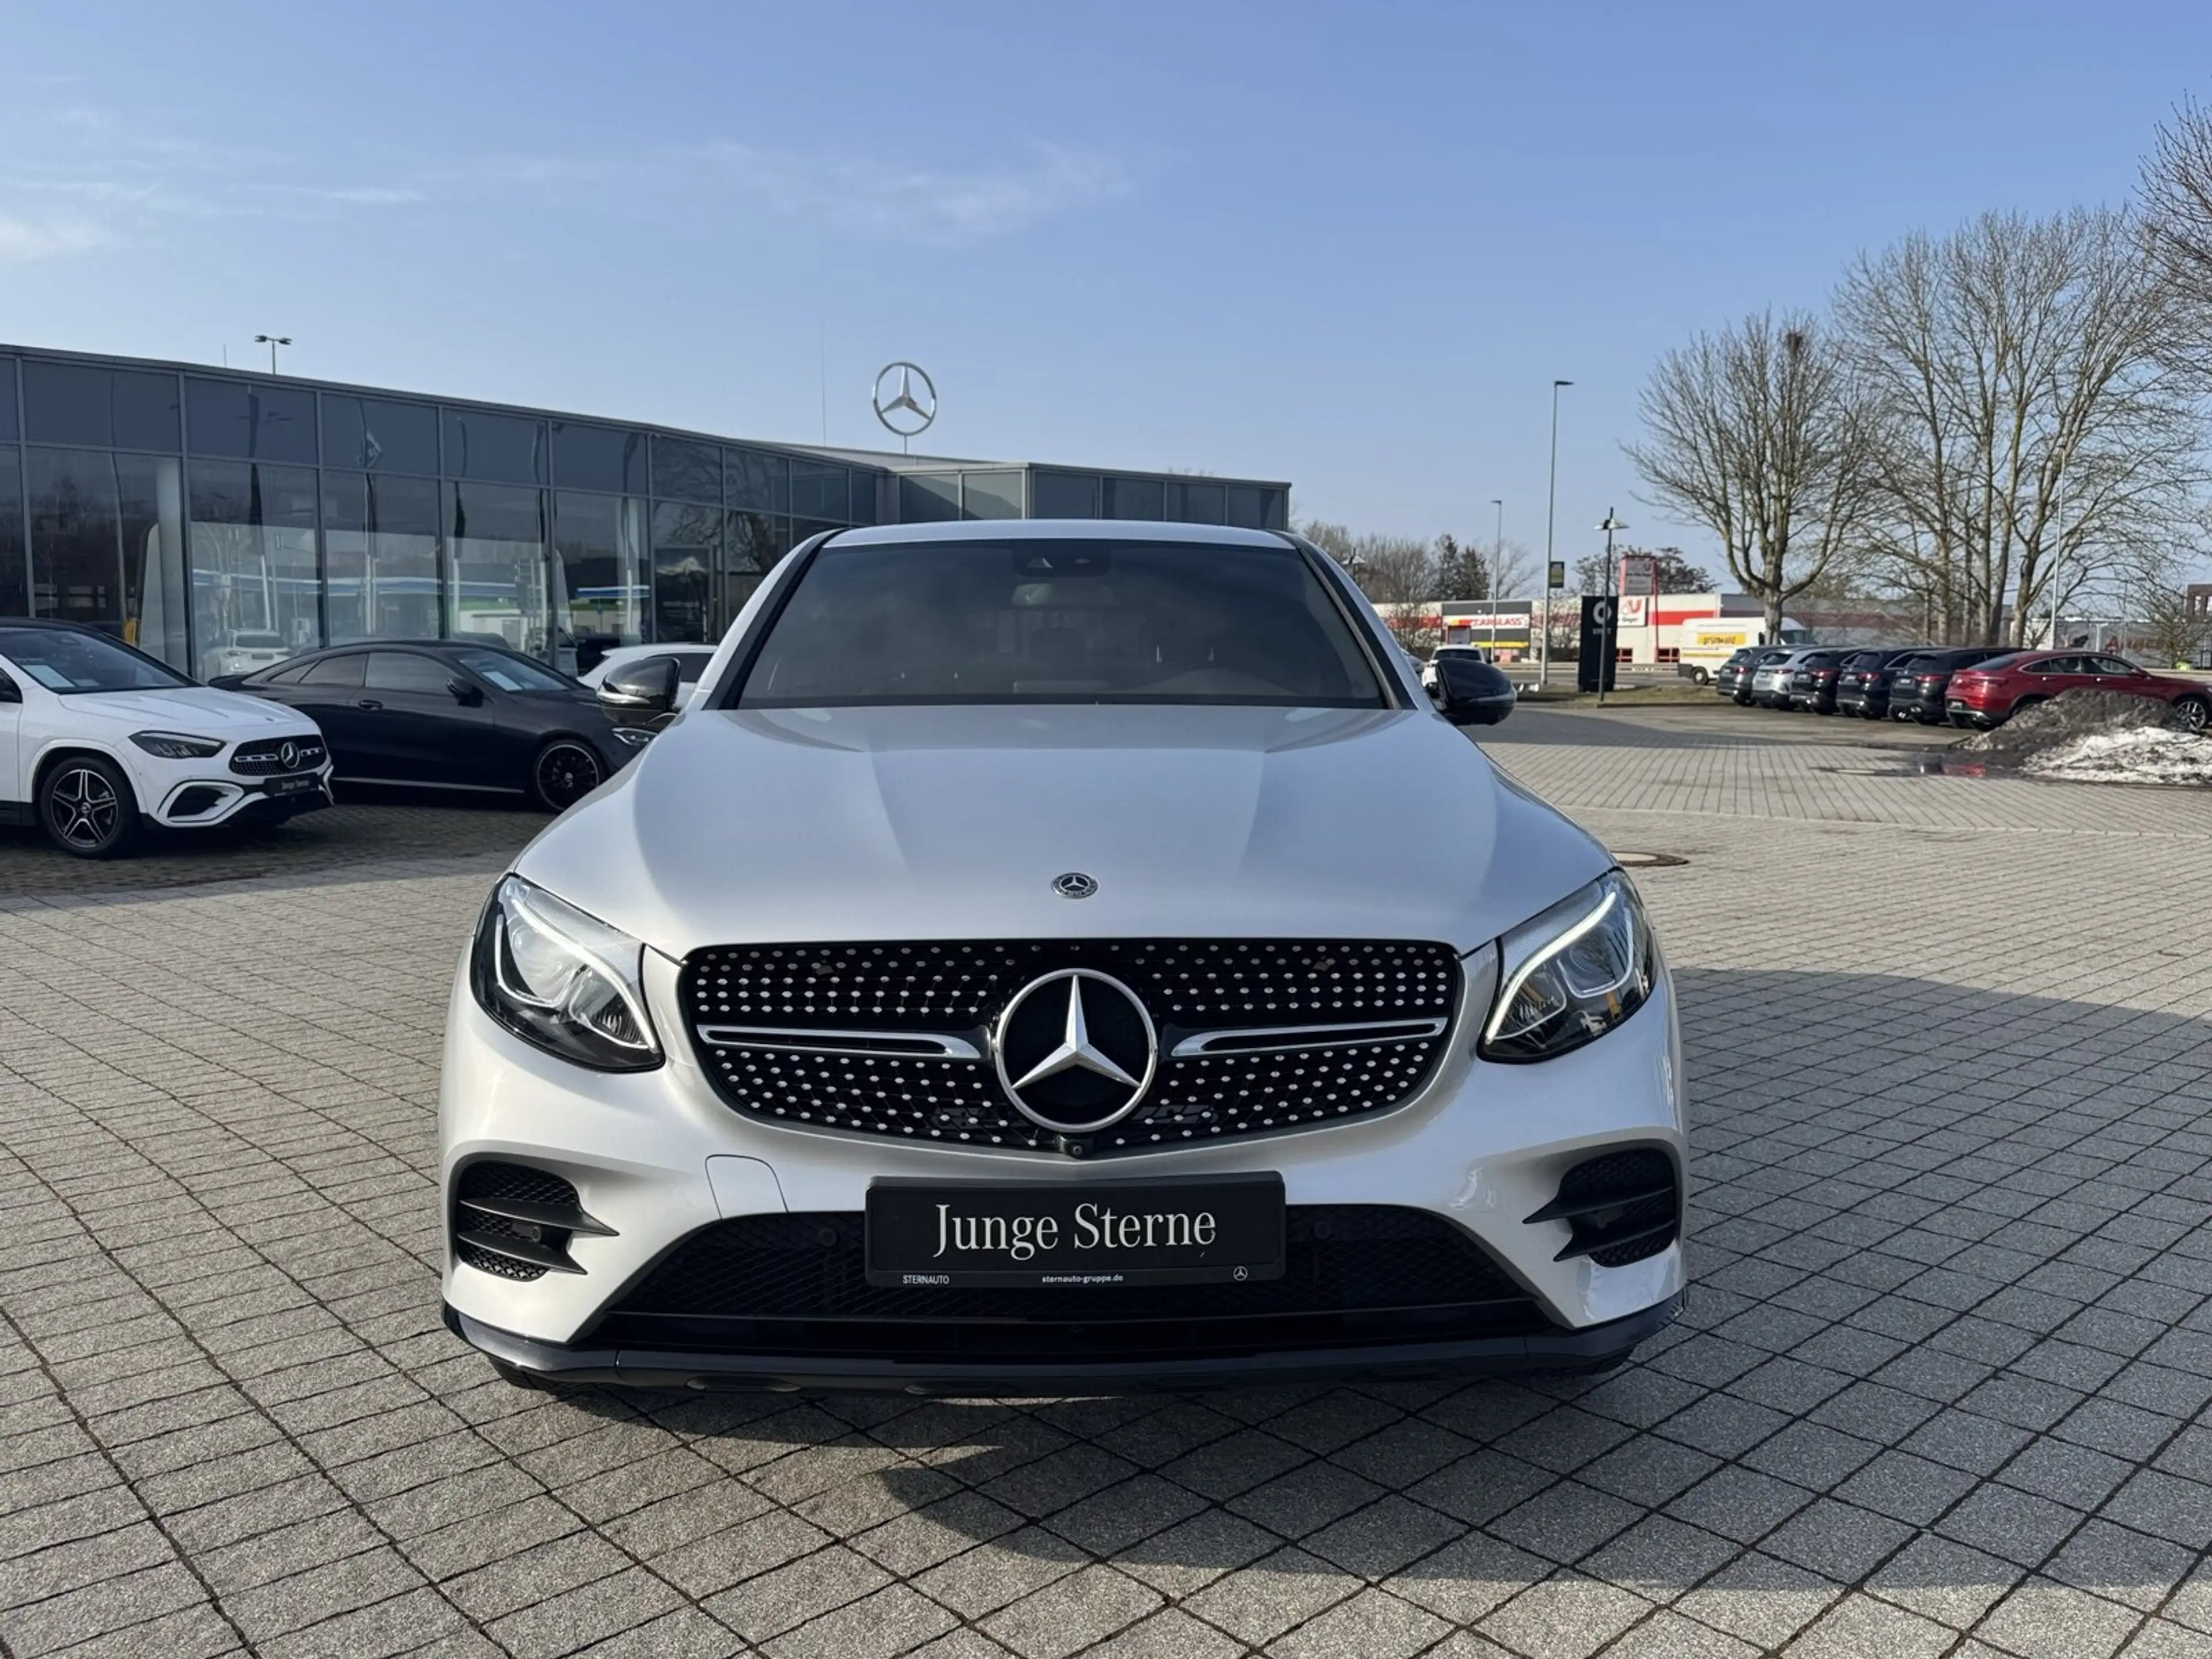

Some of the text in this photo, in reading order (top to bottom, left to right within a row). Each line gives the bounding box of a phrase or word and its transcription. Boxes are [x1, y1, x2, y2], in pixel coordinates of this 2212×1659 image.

[933, 1202, 1216, 1260] Junge Sterne
[902, 1274, 949, 1285] STERNAUTO
[1041, 1274, 1124, 1285] sternauto-gruppe.de
